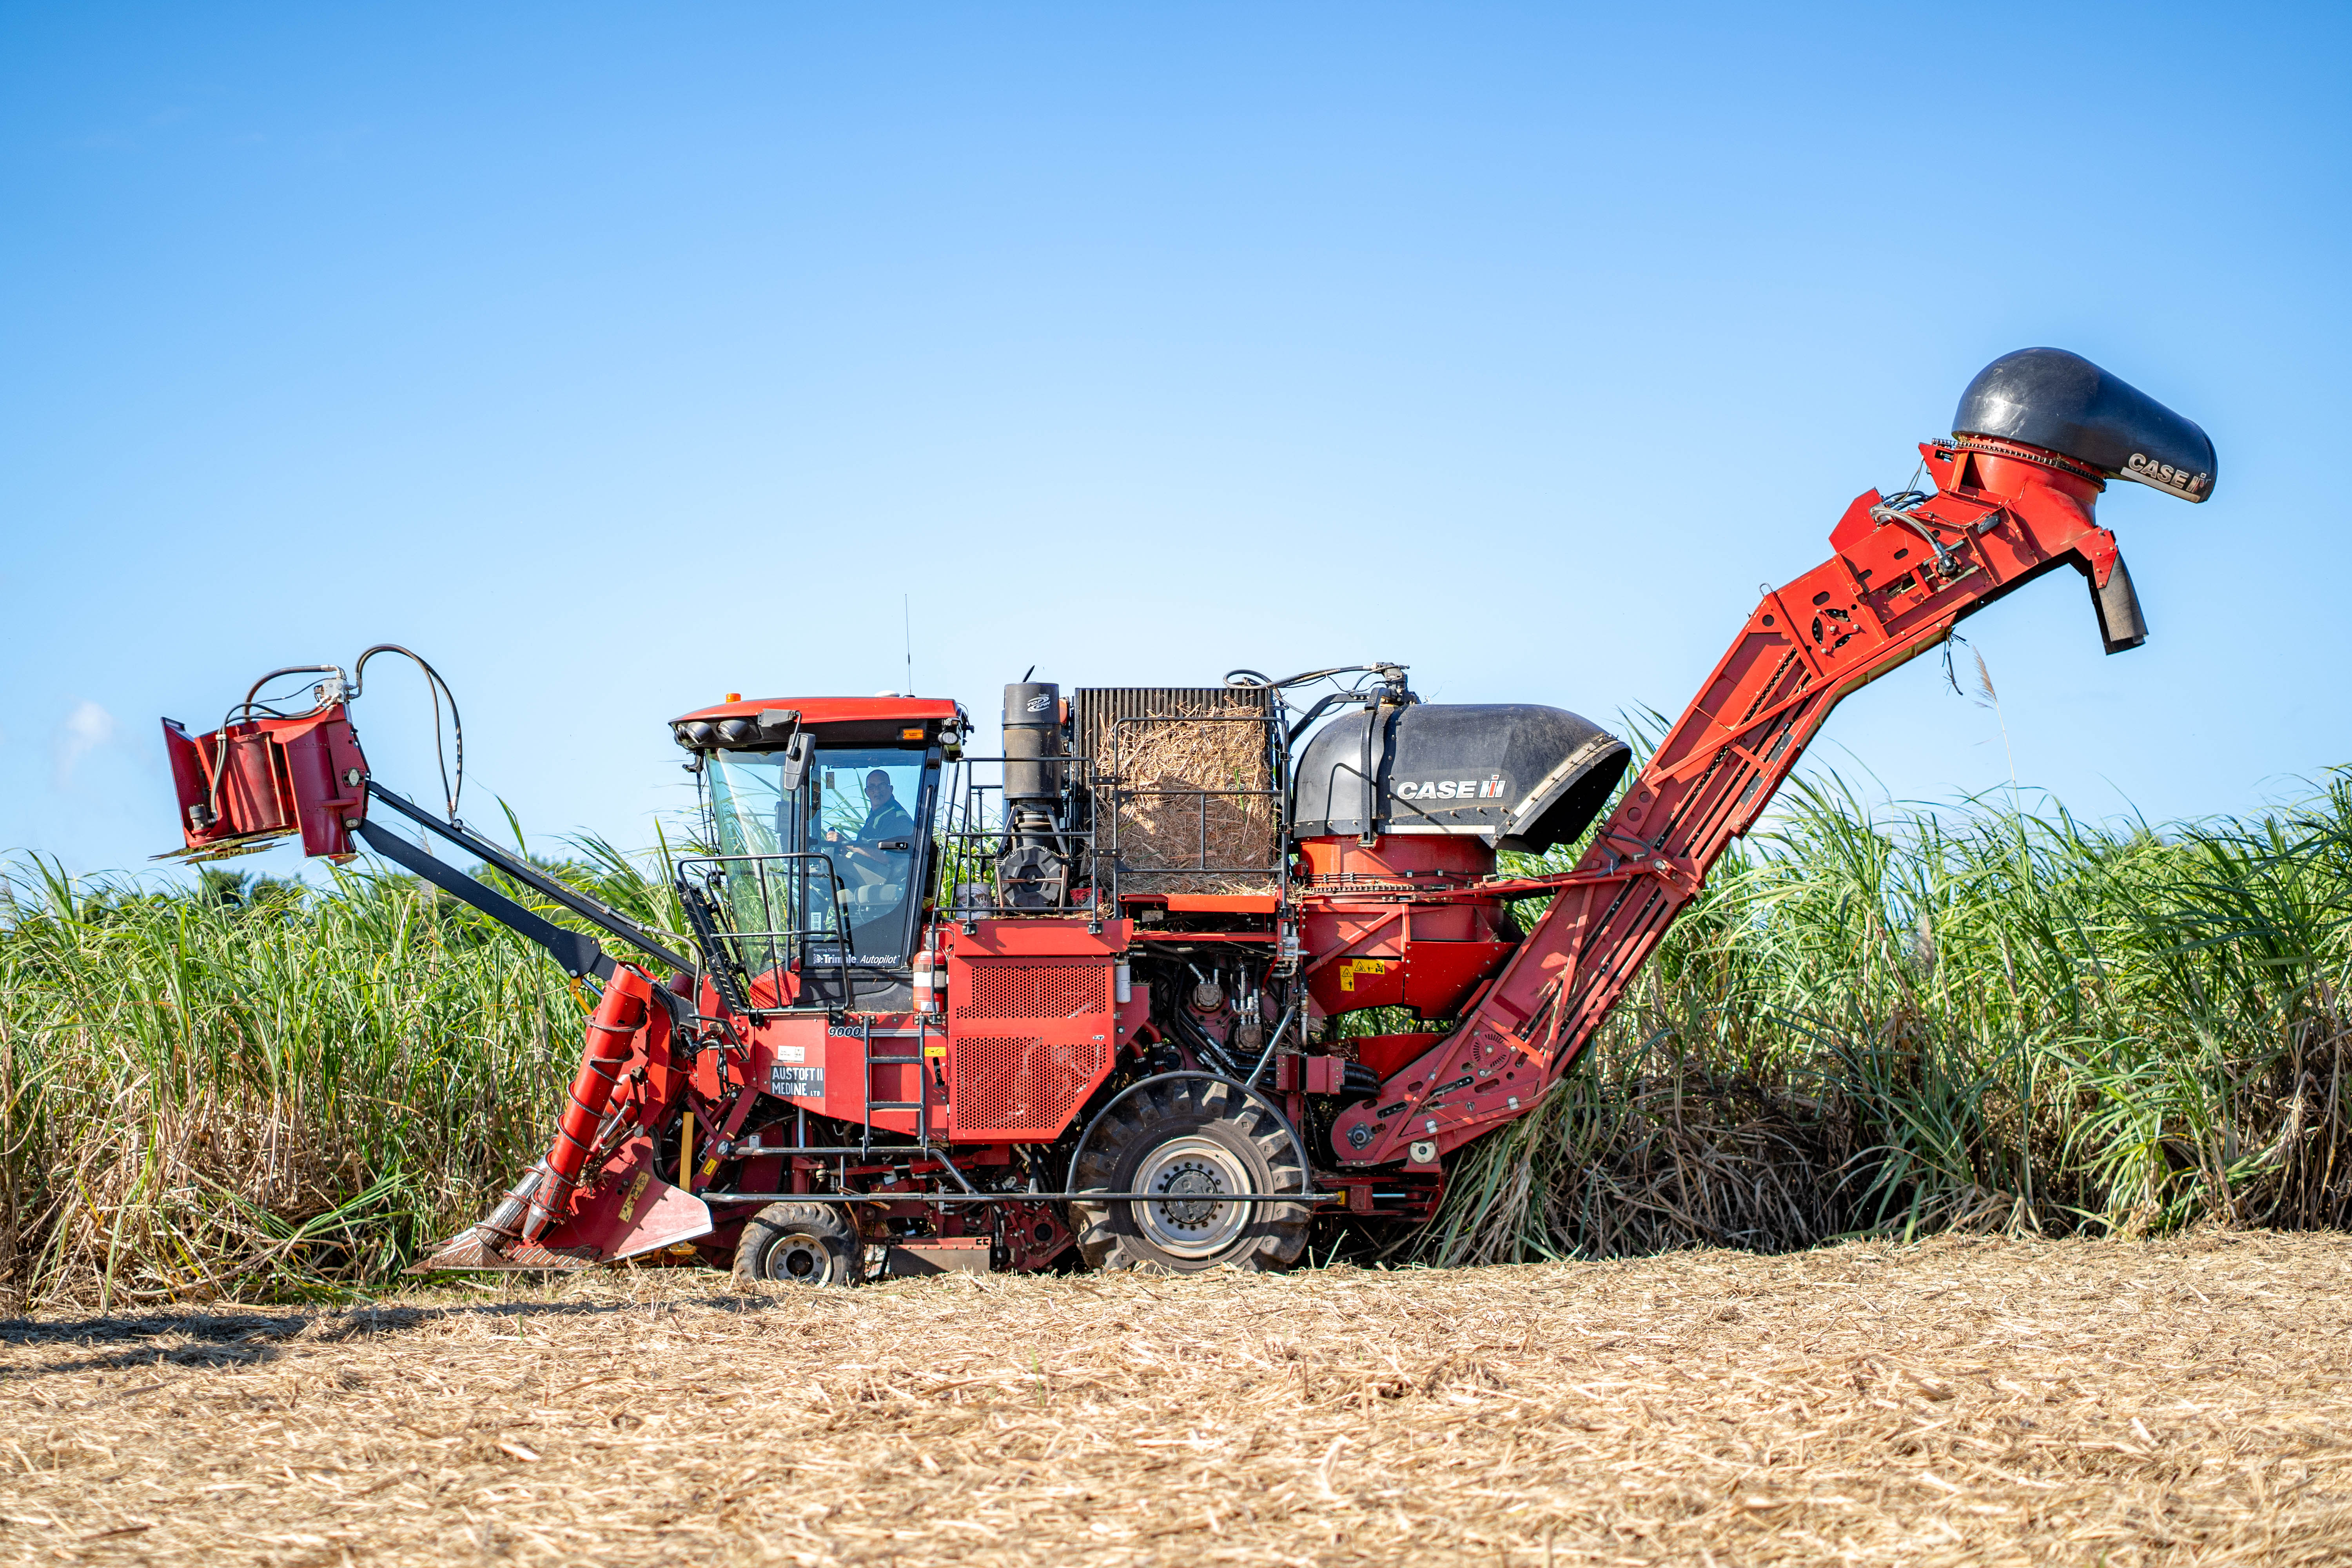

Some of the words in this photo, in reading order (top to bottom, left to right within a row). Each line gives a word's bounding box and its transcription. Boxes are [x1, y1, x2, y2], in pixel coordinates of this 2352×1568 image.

[2129, 453, 2189, 488] CASE
[1397, 780, 1477, 800] CASE
[828, 1027, 861, 1037] 9000
[772, 1067, 815, 1081] AUSTOFT
[772, 1082, 807, 1096] MEDINE
